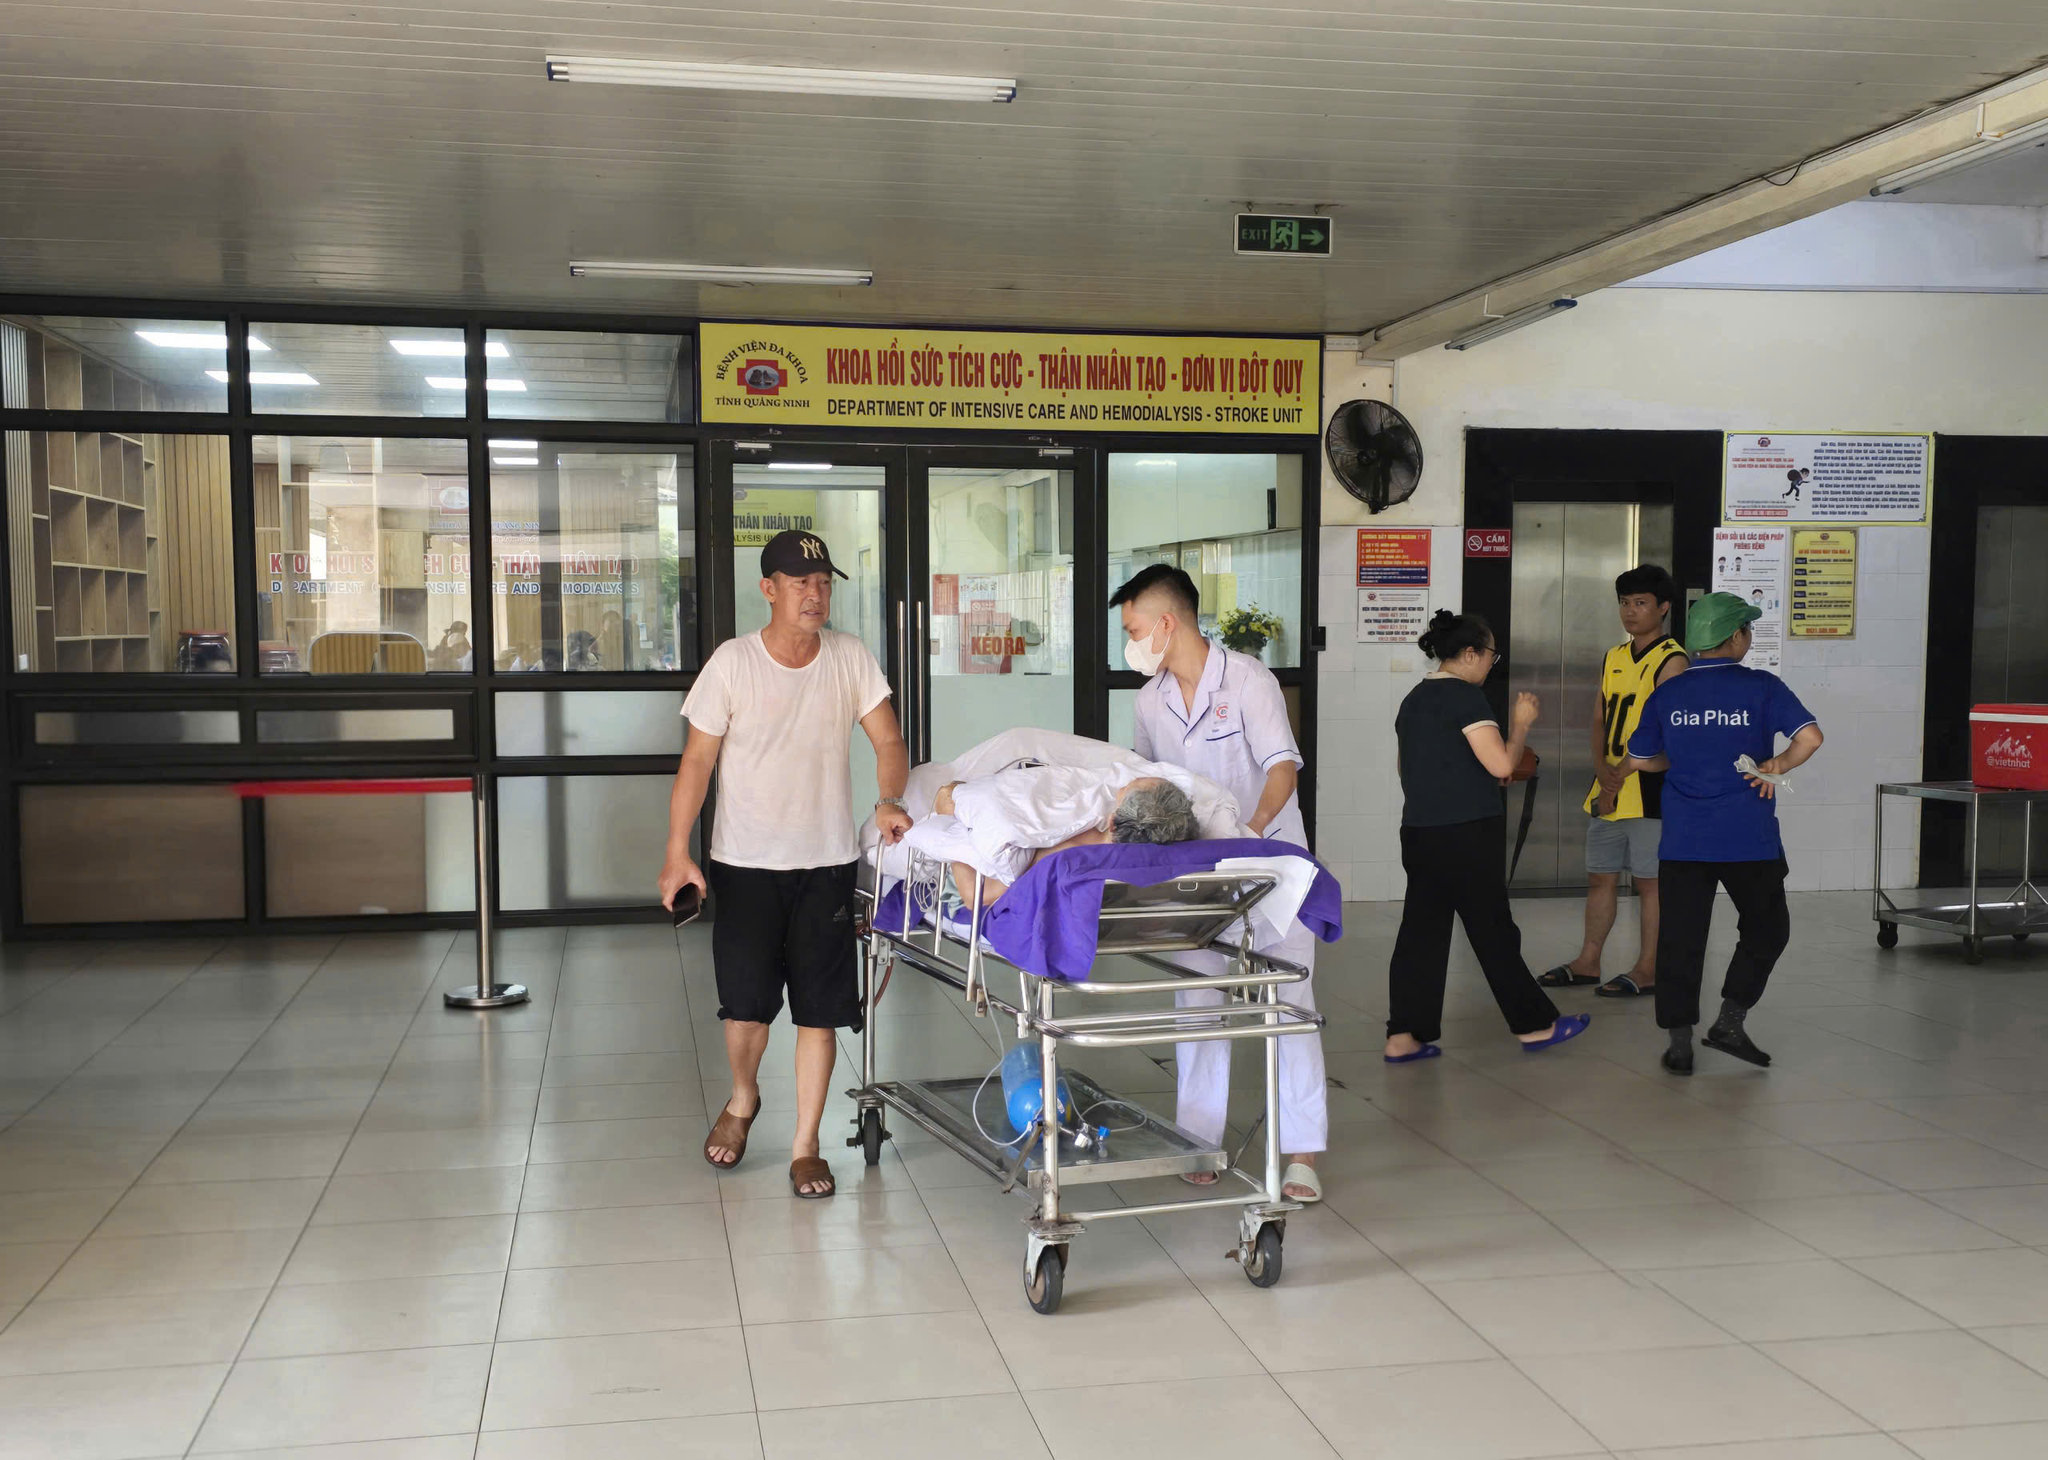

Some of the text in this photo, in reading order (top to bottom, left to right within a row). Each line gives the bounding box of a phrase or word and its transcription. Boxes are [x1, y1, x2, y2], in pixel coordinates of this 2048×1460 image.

[1241, 228, 1269, 241] EXIT
[716, 340, 808, 384] BỆNH VIỆN ĐA KHOA
[826, 347, 872, 385] KHOA
[877, 337, 905, 386] HỒI
[910, 343, 943, 387] SỨC
[948, 344, 985, 388] TÍCH
[990, 349, 1023, 396] CỰC
[1039, 346, 1081, 398] THẬN
[1086, 347, 1131, 391] NHÂN
[1136, 356, 1166, 400] TẠO
[1182, 354, 1215, 392] ĐƠN
[1219, 358, 1234, 401] VỊ
[1239, 350, 1269, 401] ĐỘT
[1273, 358, 1303, 402] QUỴ
[715, 395, 810, 408] TỈNH QUẢNG NINH
[827, 399, 925, 417] DEPARTMENT
[929, 401, 947, 417] OF
[951, 402, 1024, 419] INTENSIVE
[1028, 403, 1065, 420] CARE
[1070, 404, 1098, 420] AND
[1103, 405, 1203, 421] HEMODIALYSIS
[1215, 406, 1268, 422] STROKE
[1273, 408, 1303, 423] UNIT
[734, 534, 762, 542] LYSIS
[1486, 533, 1506, 543] CẤM
[271, 581, 362, 594] DPARTMENT
[511, 581, 541, 595] AND
[1670, 708, 1750, 726] Gia Phát
